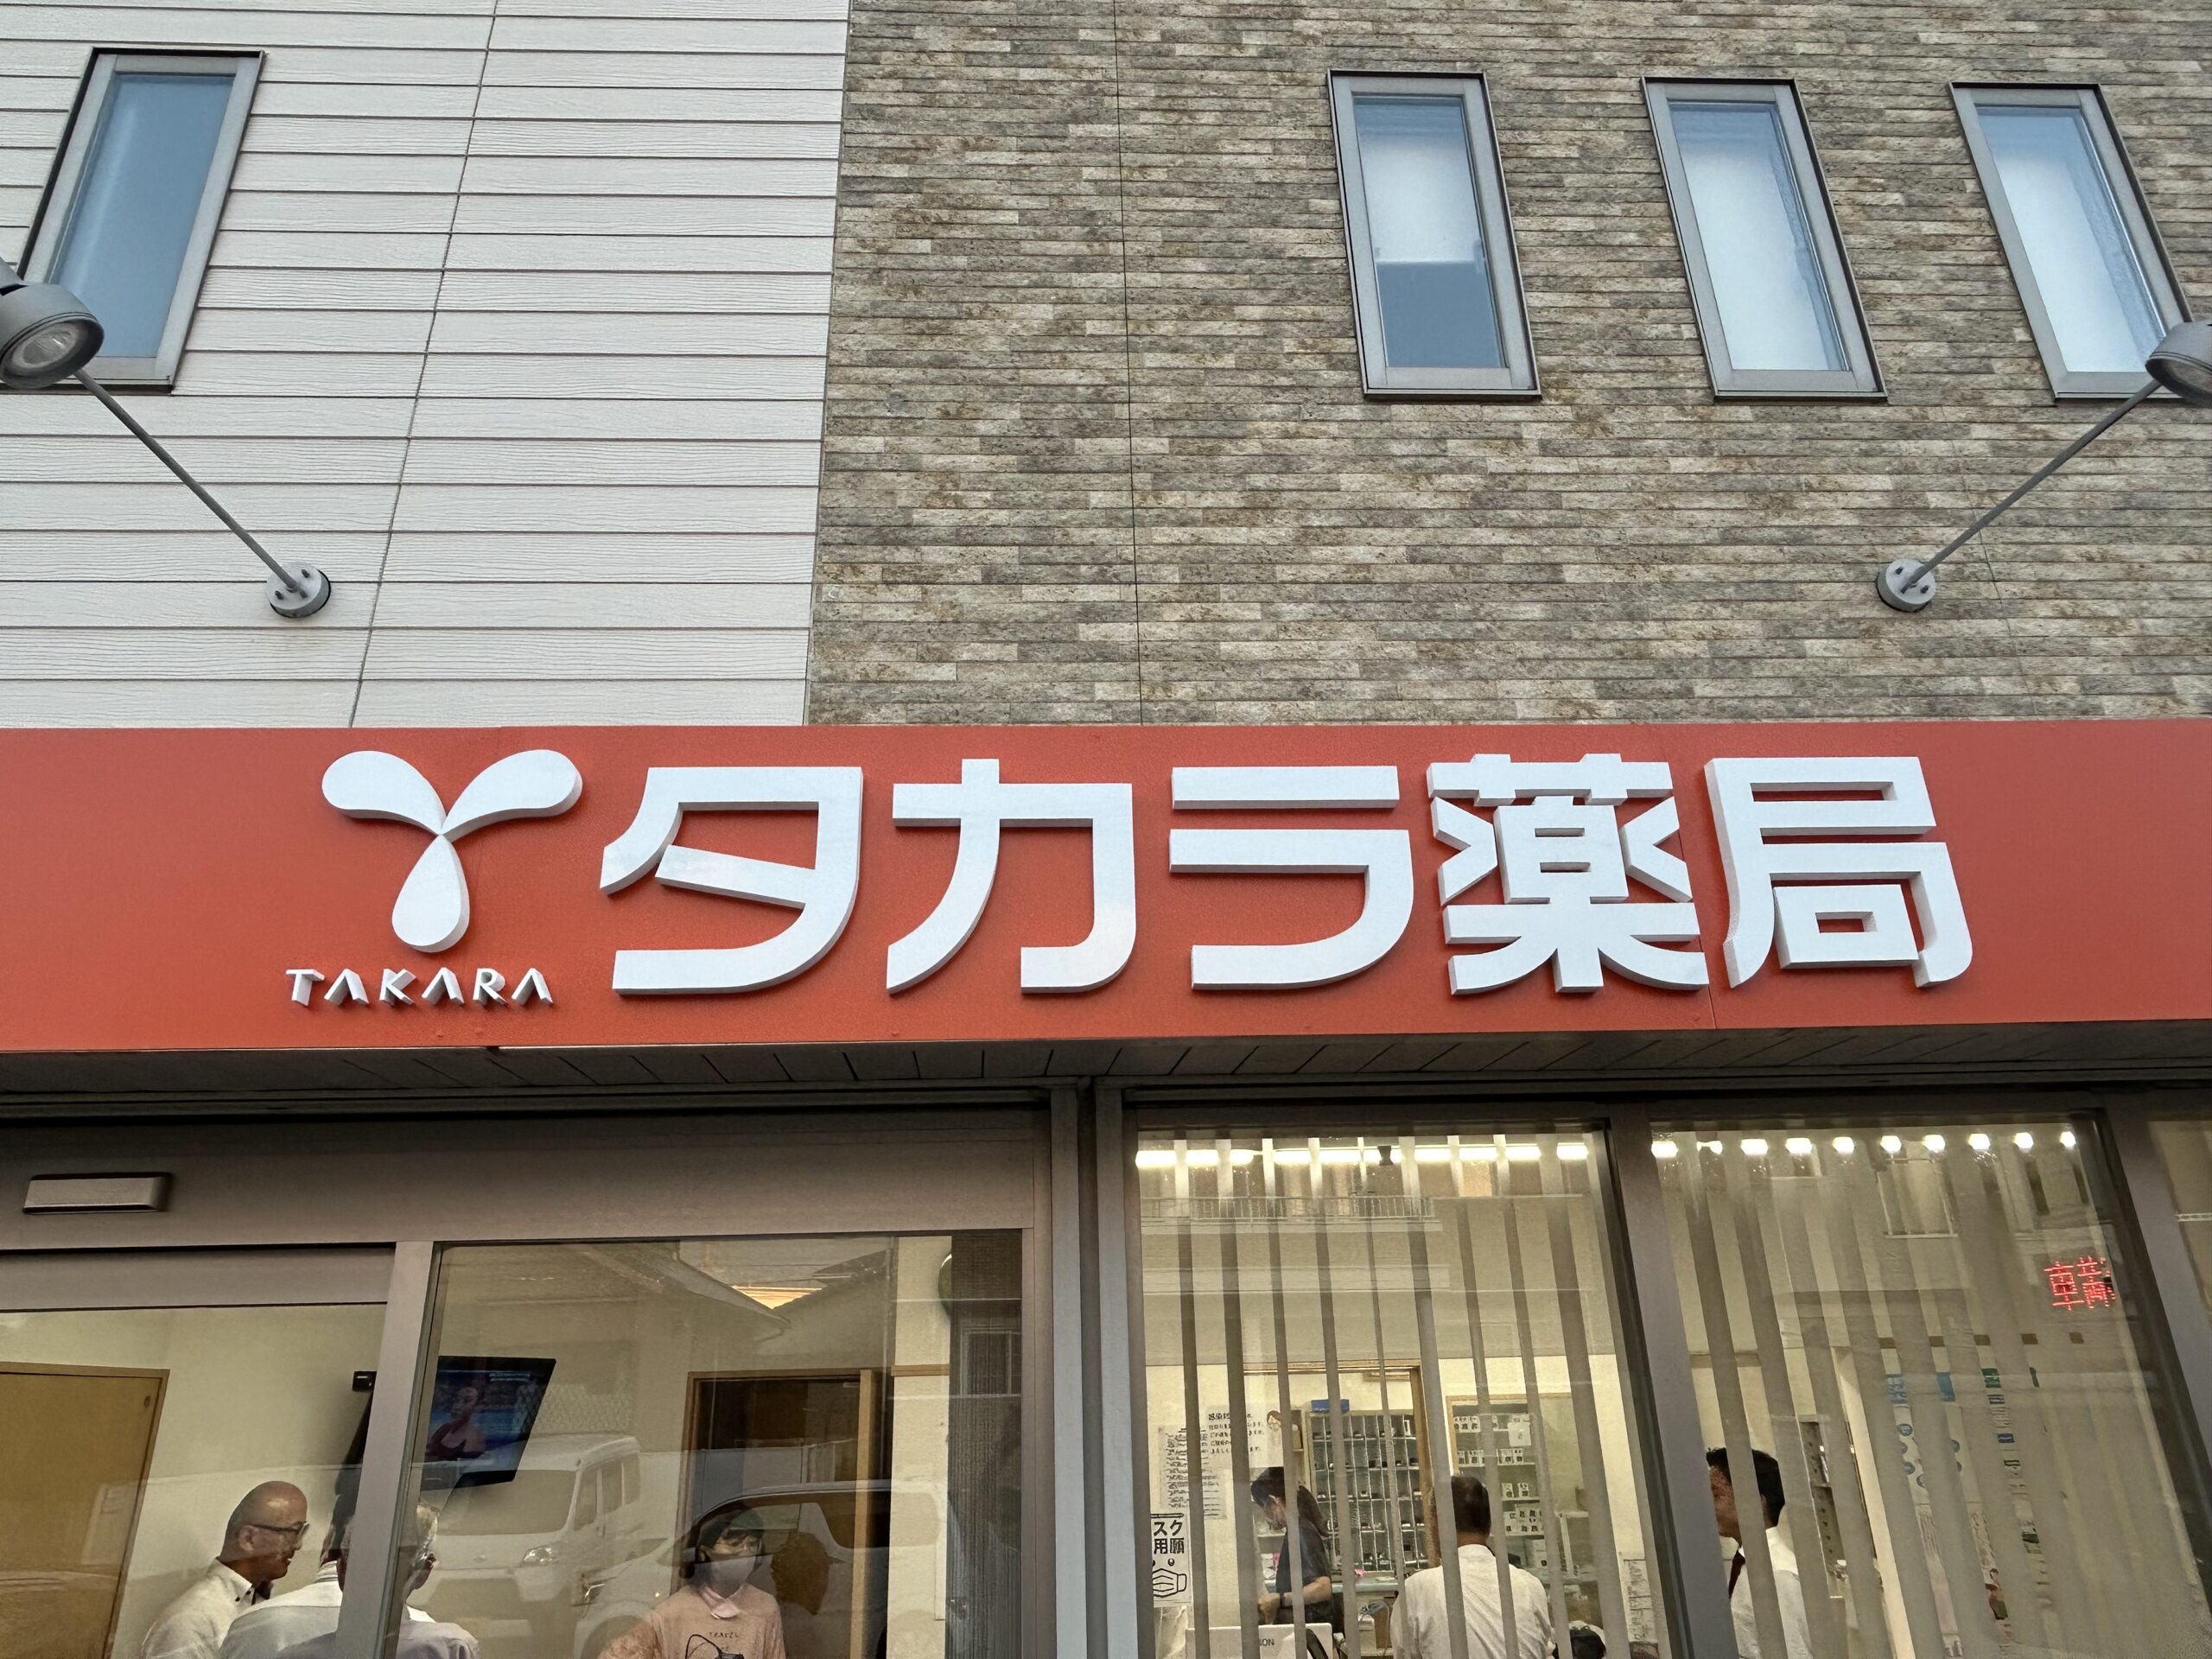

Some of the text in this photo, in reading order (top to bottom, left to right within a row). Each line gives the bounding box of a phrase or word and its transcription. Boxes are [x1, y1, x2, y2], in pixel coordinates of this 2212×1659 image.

[600, 753, 1973, 995] タカラ薬局
[285, 967, 553, 1007] TAKARA
